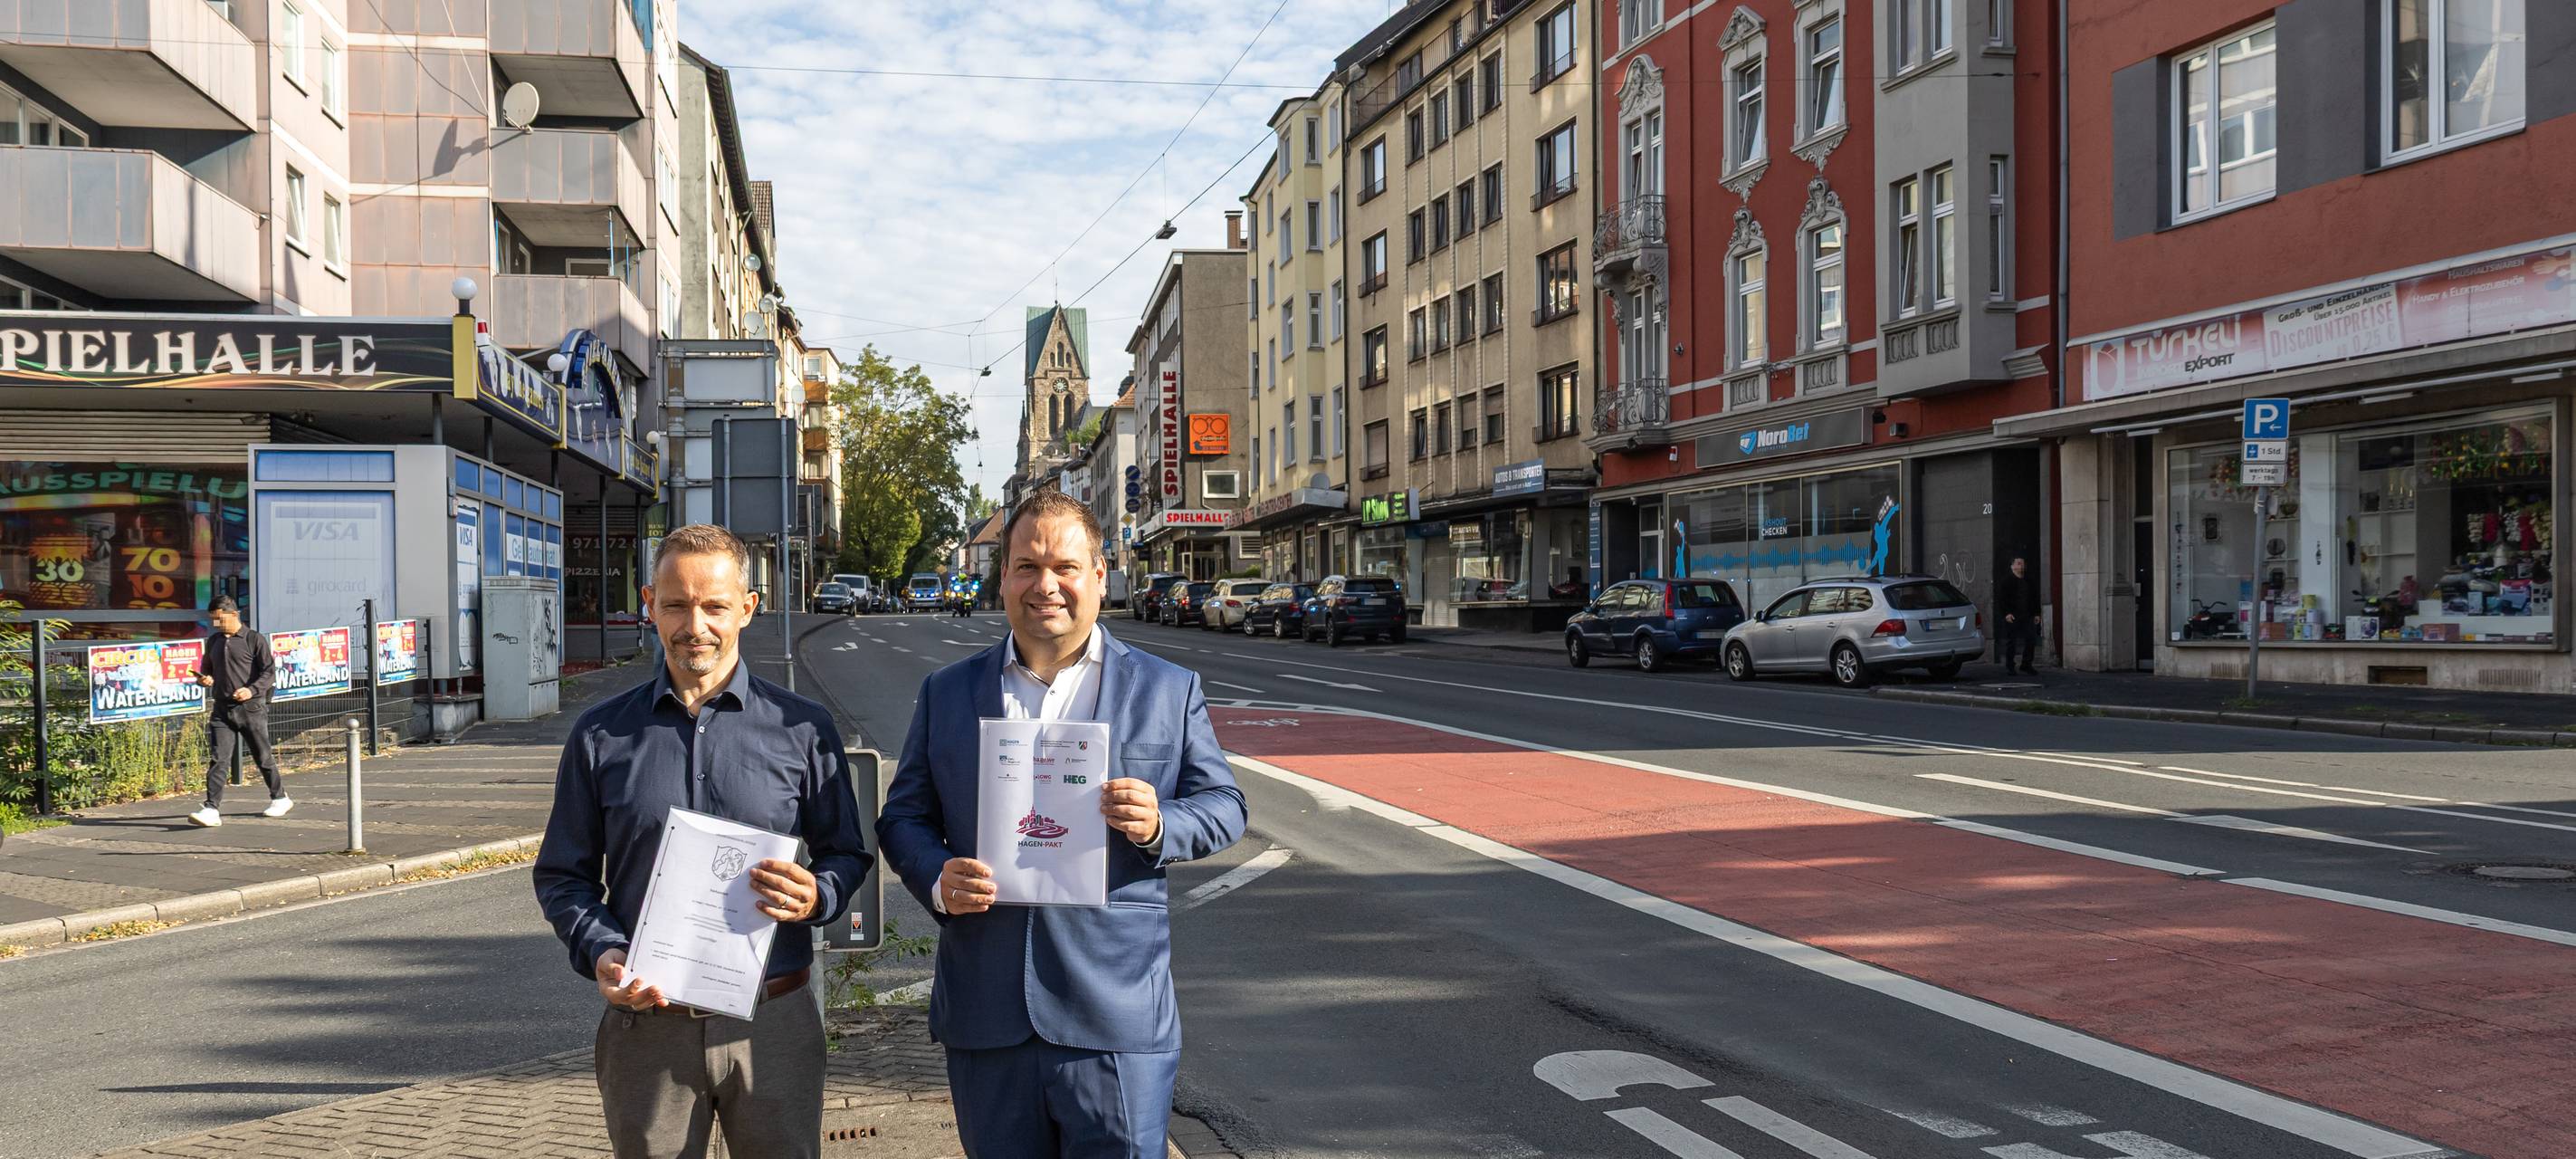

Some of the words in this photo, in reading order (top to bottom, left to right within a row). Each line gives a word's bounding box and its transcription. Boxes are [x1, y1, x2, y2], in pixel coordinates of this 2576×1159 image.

[2447, 258, 2526, 280] HAUSHALTSWAREN
[2362, 291, 2392, 304] ARTIKEL
[2413, 292, 2442, 304] HANDY
[2449, 275, 2524, 298] ELEKTROZUBEHÖR
[2306, 302, 2324, 313] UND
[2270, 301, 2392, 358] DISCOUNTPREISE
[2184, 353, 2235, 372] EXPORT
[2254, 404, 2279, 435] P
[1163, 371, 1178, 496] SPIELHALLE
[1757, 422, 1809, 447] NoroBet
[1512, 465, 1542, 480] TRANSPORTER
[1371, 498, 1389, 522] Shop
[1982, 503, 1992, 514] 20
[293, 521, 359, 541] VISA
[459, 526, 473, 547] VISA
[1760, 526, 1788, 537] CHECKEN
[573, 537, 602, 549] 971
[607, 538, 627, 549] 72
[120, 547, 181, 572] 70
[35, 559, 85, 582] 30
[565, 567, 622, 577] PIZZEIA
[127, 574, 175, 599] 10
[308, 576, 367, 596] girocard
[166, 648, 196, 658] HAGEN
[273, 636, 319, 652] CIRCUS
[91, 649, 159, 668] CIRCUS
[167, 665, 177, 678] 2
[275, 666, 348, 690] WATERLAND
[95, 684, 202, 710] WATERLAND
[1064, 774, 1086, 784] HEG
